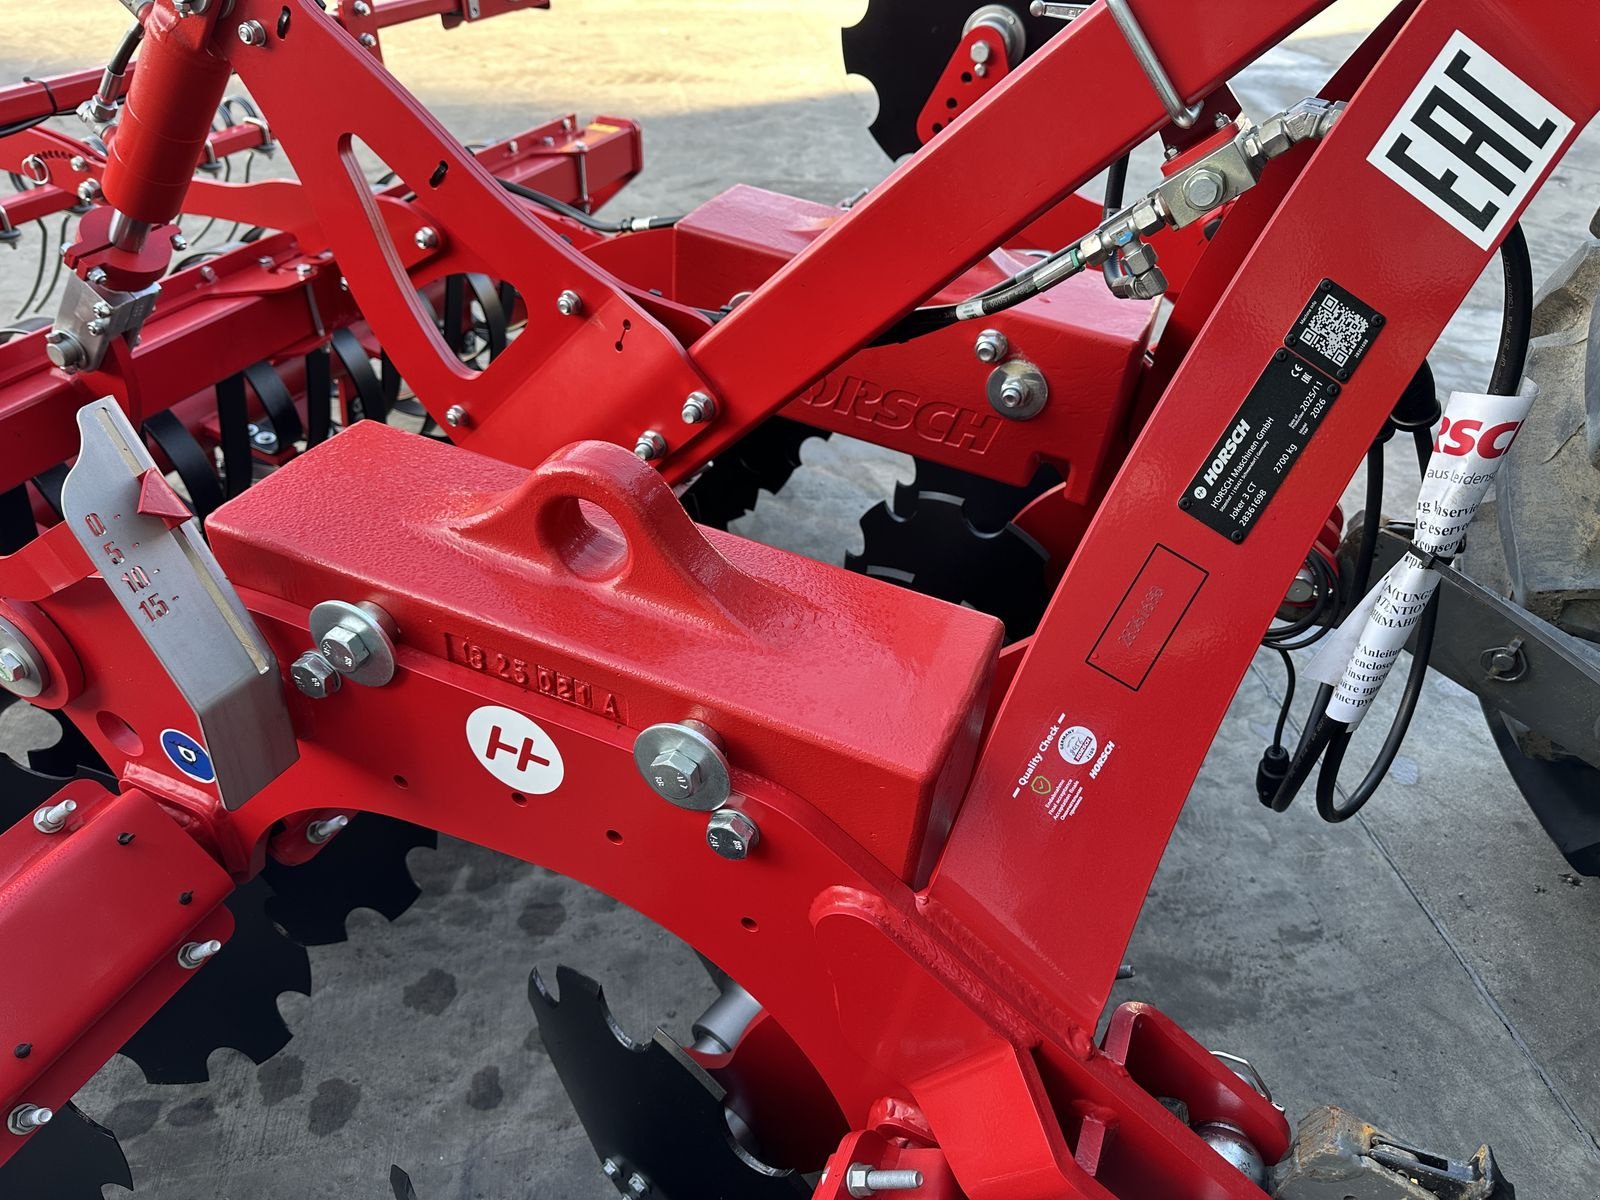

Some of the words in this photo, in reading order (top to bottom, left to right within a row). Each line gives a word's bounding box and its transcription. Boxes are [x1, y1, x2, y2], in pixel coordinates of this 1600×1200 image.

[1300, 380, 1322, 411] 2025/11
[1310, 398, 1326, 417] 2026
[800, 376, 1003, 454] ORSCH
[1204, 419, 1251, 487] HORSCH
[1211, 477, 1233, 508] HORSCH
[1231, 439, 1258, 477] Maschinen
[1256, 416, 1273, 439] GmbH
[1239, 488, 1266, 526] 28361698
[1273, 453, 1289, 472] 2700
[1286, 443, 1297, 454] kg
[1427, 468, 1448, 481] aus
[1229, 499, 1245, 519] Joker
[1241, 491, 1250, 500] 3
[1246, 481, 1257, 493] CT
[85, 513, 107, 537] 0
[103, 541, 125, 565] 5
[121, 566, 151, 594] 10
[139, 592, 169, 622] 15
[1018, 752, 1043, 786] Quality
[1039, 724, 1060, 752] Check
[1074, 737, 1091, 760] HORSCH
[1089, 740, 1116, 779] HORSCH
